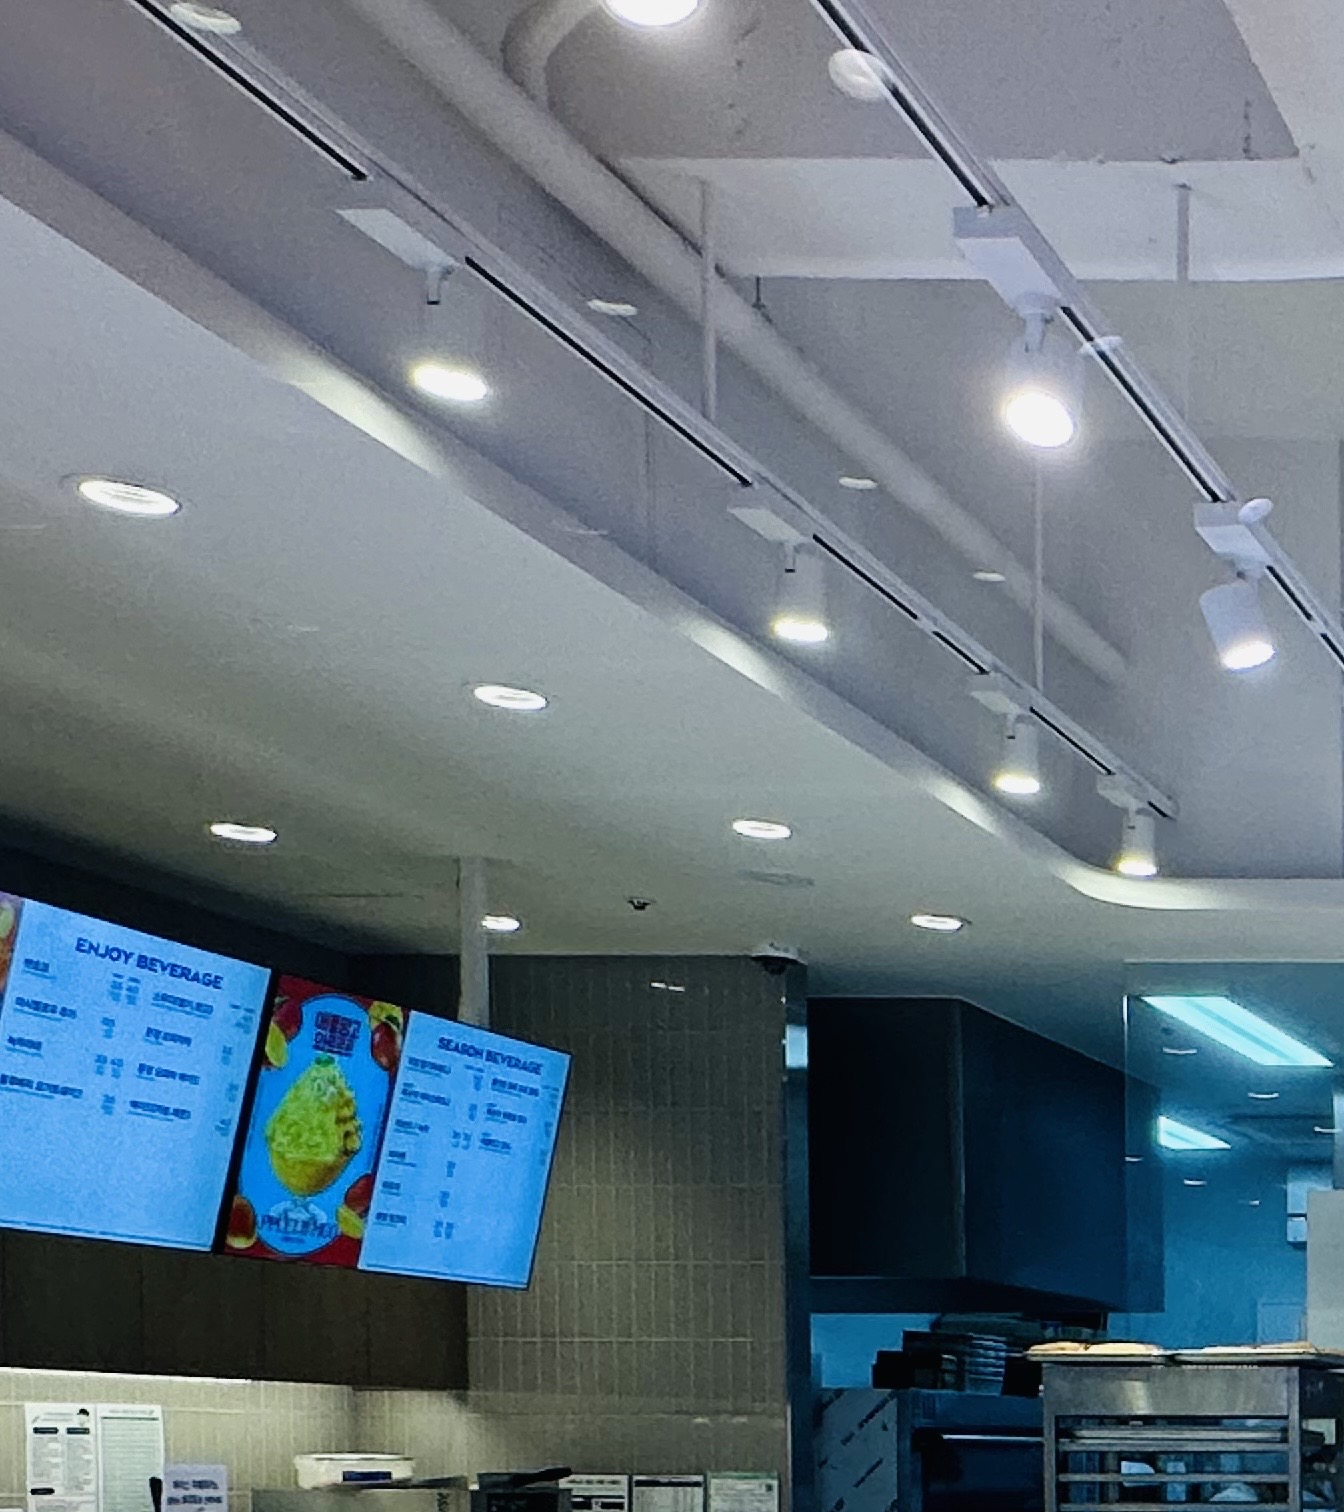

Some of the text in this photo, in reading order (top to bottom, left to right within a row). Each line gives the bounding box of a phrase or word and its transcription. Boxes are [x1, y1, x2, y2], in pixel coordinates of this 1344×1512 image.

[75, 937, 224, 990] ENJOY BEVERAGE
[437, 1036, 544, 1076] SEASON BEVERAGE
